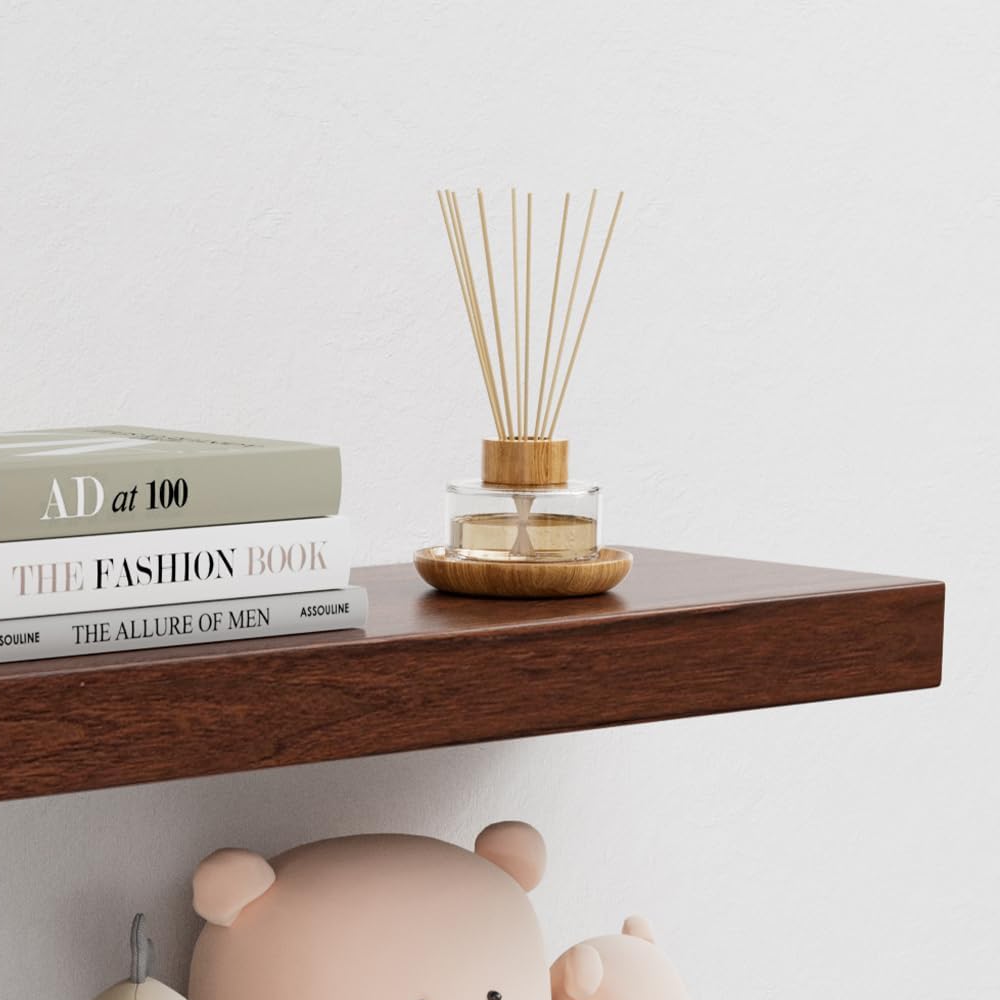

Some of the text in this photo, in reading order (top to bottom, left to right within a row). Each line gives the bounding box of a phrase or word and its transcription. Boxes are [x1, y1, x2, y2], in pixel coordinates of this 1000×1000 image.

[40, 475, 188, 520] AD at 100
[12, 541, 328, 596] THE FASHION BOOK
[72, 607, 271, 645] THE ALLURE OF MEN
[300, 603, 350, 618] ASSOULINE
